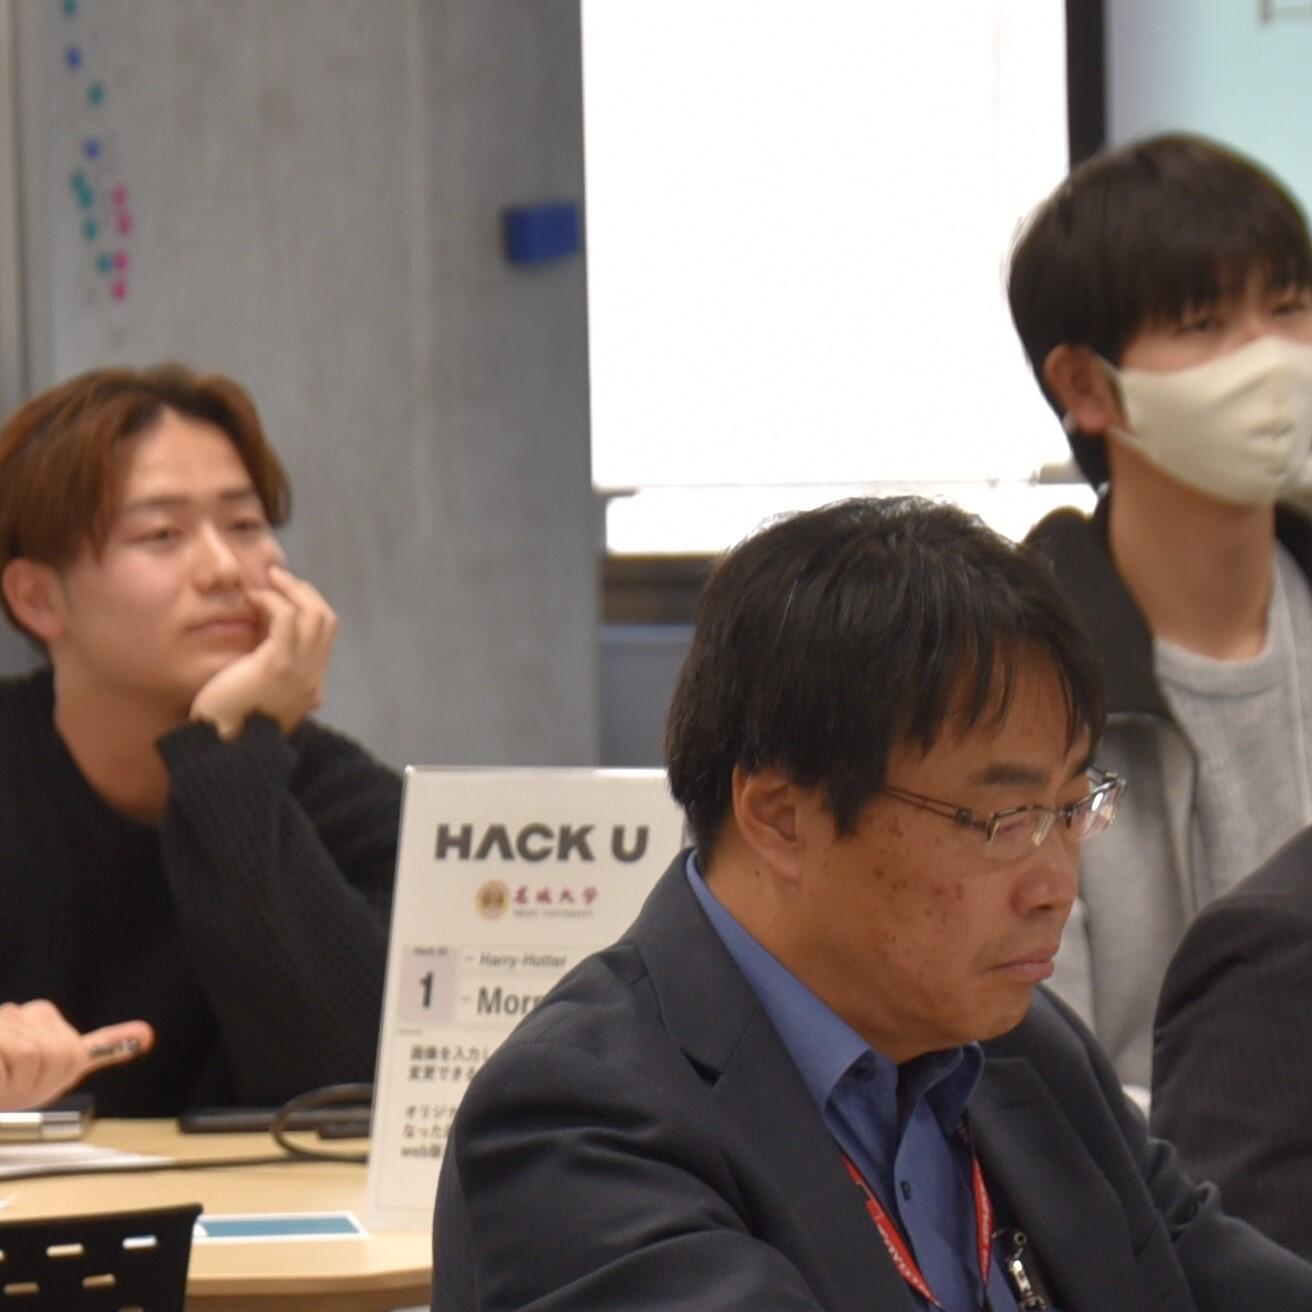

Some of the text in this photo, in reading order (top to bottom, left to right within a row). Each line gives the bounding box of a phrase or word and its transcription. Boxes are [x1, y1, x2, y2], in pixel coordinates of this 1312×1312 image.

[434, 823, 649, 863] HACK U
[420, 971, 434, 1009] 1
